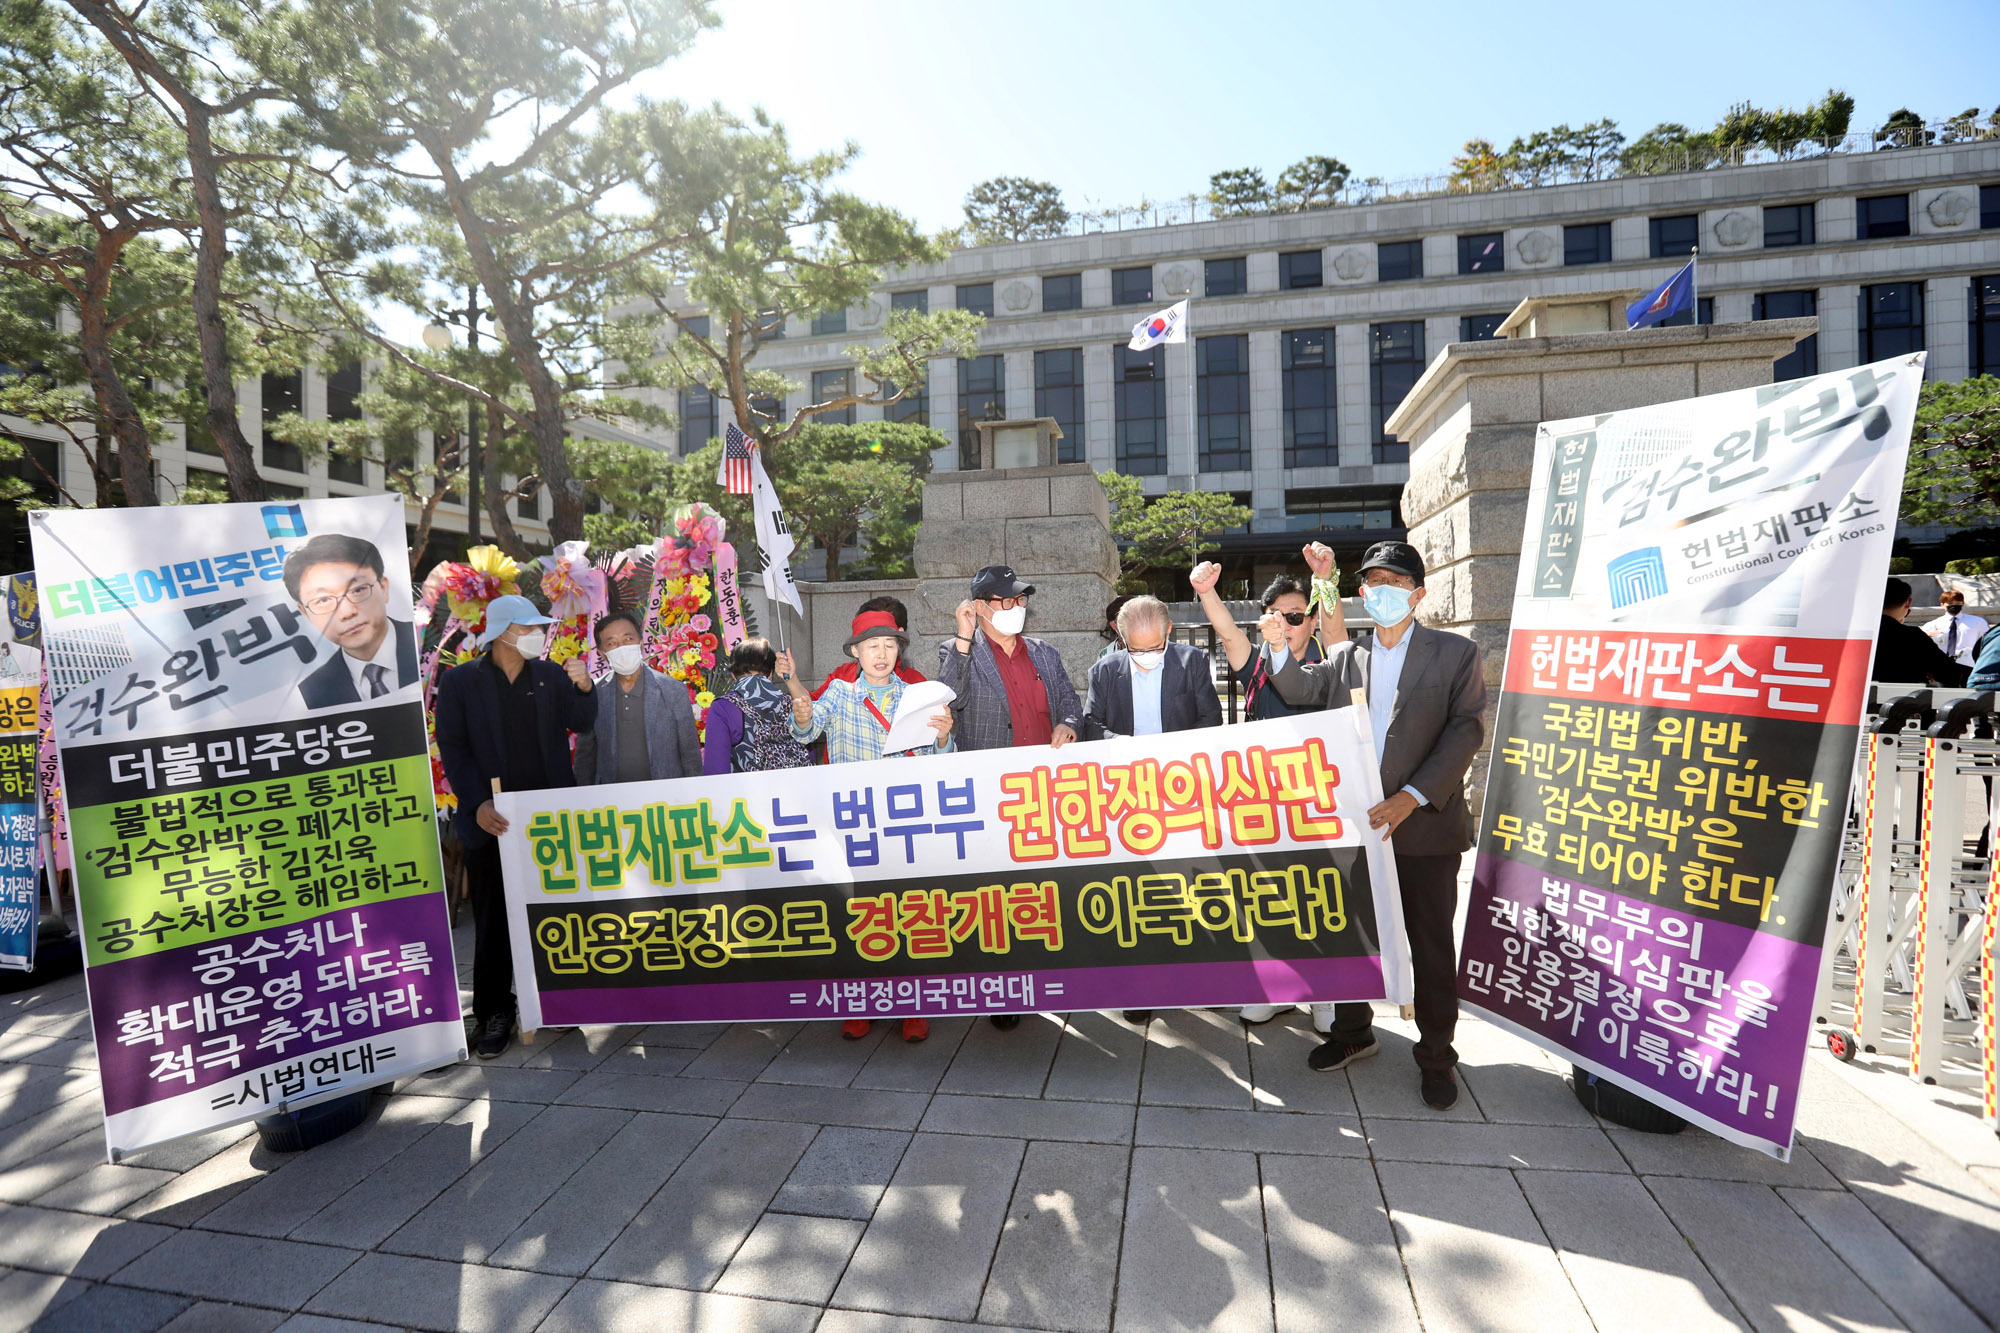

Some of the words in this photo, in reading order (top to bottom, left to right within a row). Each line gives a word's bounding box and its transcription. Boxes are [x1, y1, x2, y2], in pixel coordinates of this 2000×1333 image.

[1618, 368, 1897, 529] 검수완박
[1541, 436, 1588, 590] 헌법재판소
[1681, 491, 1880, 570] 헌법재판소
[45, 544, 289, 619] 더불어민주당
[1687, 552, 1774, 585] Constitutional
[1777, 544, 1815, 560] Court
[1820, 534, 1834, 547] of
[1838, 522, 1886, 542] Korea
[13, 616, 36, 630] POLICE
[719, 568, 740, 626] 한동훈
[1530, 635, 1831, 714] 헌법재판소는
[109, 721, 375, 790] 더불민주당은
[1542, 702, 1640, 751] 국회법
[1652, 716, 1759, 769] 위반,
[110, 783, 294, 837] 불법적으로
[304, 764, 398, 809] 통과된
[297, 795, 429, 842] 폐지하고,
[526, 797, 817, 894] 헌법재판소는
[832, 777, 985, 867] 법무부
[999, 737, 1343, 863] 권한쟁의심판
[1501, 737, 1661, 799] 국민기본권
[1674, 766, 1829, 829] 위반한
[97, 888, 288, 954] 공수처장은
[295, 860, 429, 909] 해임하고,
[160, 856, 271, 904] 무능한
[282, 834, 376, 882] 김진욱
[1492, 814, 1549, 858] 무효
[1555, 834, 1668, 896] 되어야
[1680, 862, 1787, 926] 한다.
[192, 912, 369, 986] 공수처나
[536, 900, 836, 974] 인용결정으로
[846, 880, 1063, 962] 경찰개혁
[1077, 864, 1347, 948] 이룩하라!
[1541, 877, 1704, 961] 법무부의
[116, 971, 304, 1046] 확대운영
[316, 941, 434, 993] 되도록
[816, 974, 1035, 1013] 사법정의국민연대
[1487, 896, 1778, 1029] 권한쟁의심판을
[1502, 936, 1741, 1058] 인용결정으로
[149, 1034, 245, 1085] 적극
[256, 983, 434, 1055] 추진하라.
[1466, 961, 1585, 1037] 민주국가
[1597, 1022, 1780, 1119] 이룩하라!
[211, 1043, 397, 1111] =사법연대=
